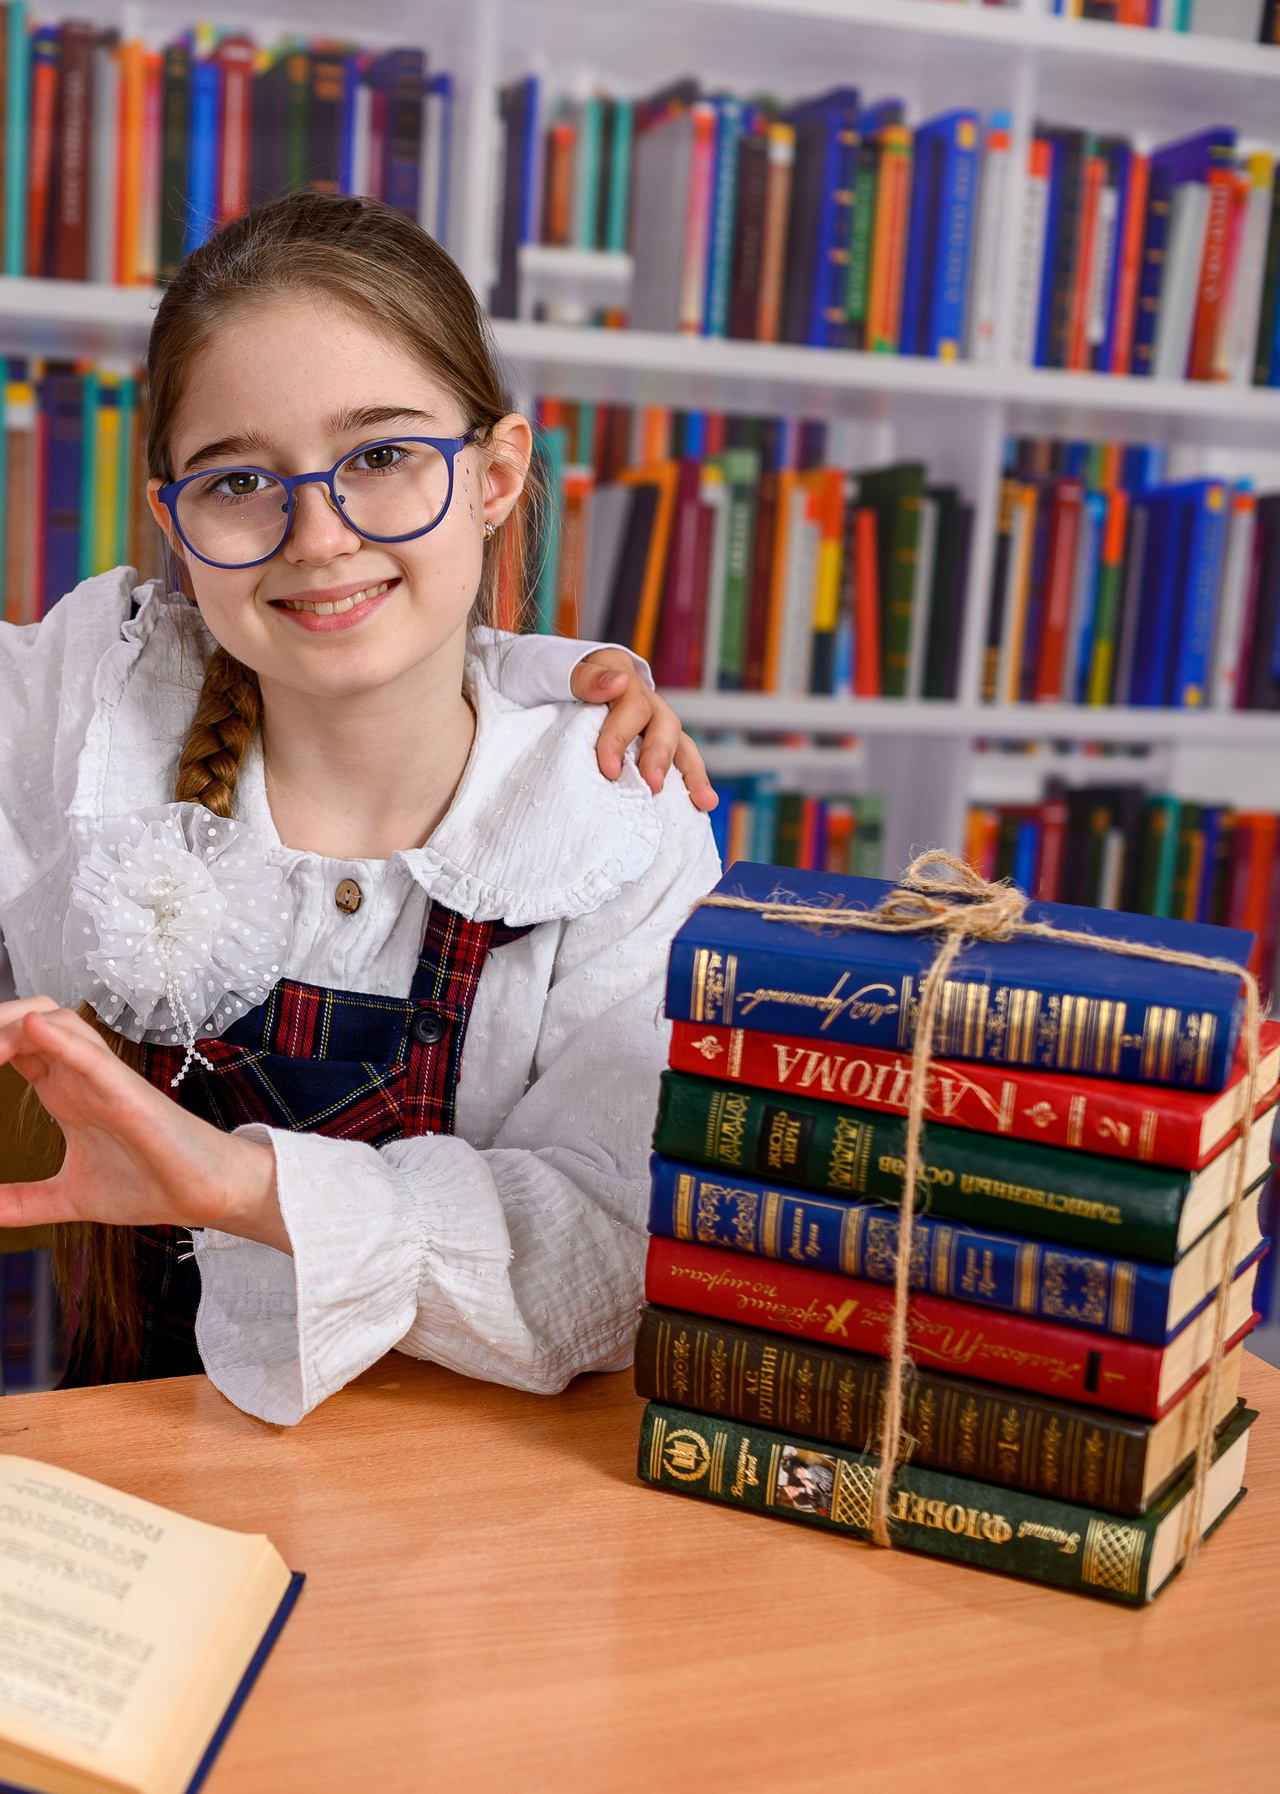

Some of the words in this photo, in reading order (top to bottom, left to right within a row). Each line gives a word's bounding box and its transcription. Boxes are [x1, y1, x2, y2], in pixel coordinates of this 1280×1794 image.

[768, 1111, 788, 1169] ЖЮЛЬ
[783, 1120, 802, 1164] ВЕРН
[1095, 1116, 1131, 1147] 2
[878, 1155, 955, 1186] ОСОВ
[736, 1293, 860, 1338] Хождение
[978, 1340, 1081, 1384] Алексей
[889, 1491, 1013, 1544] ФЛОБЕР
[1016, 1520, 1081, 1555] Гюстав
